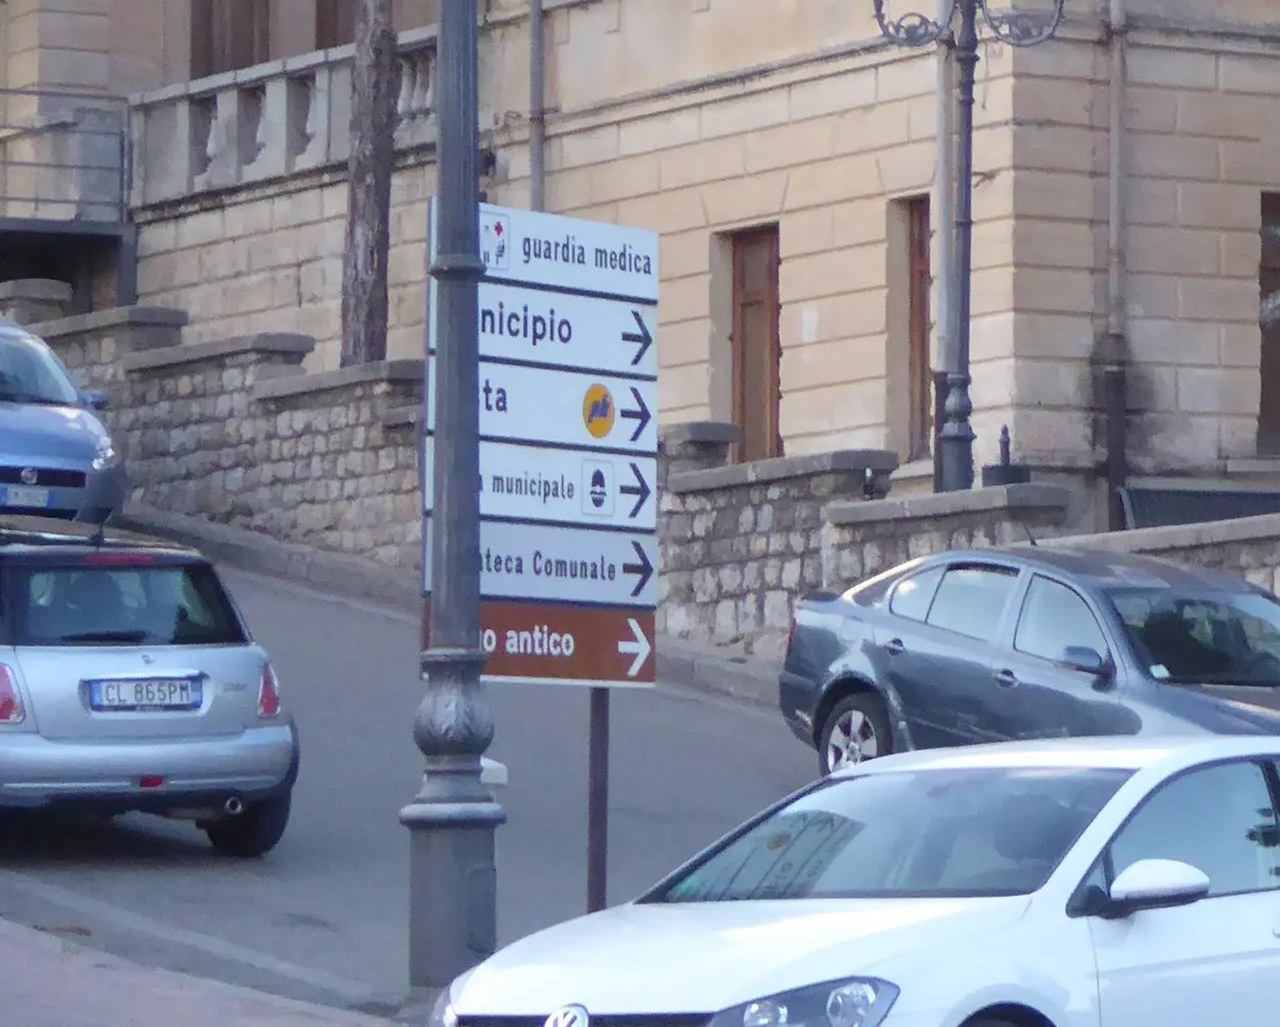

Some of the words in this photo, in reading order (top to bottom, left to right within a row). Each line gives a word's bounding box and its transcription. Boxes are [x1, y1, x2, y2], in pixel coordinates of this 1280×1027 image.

[522, 234, 586, 265] guardia
[594, 243, 652, 275] medica
[481, 301, 572, 346] nicipio
[492, 472, 575, 504] municipale
[533, 550, 616, 581] Comunale
[506, 624, 575, 656] antico
[105, 683, 127, 705] CL
